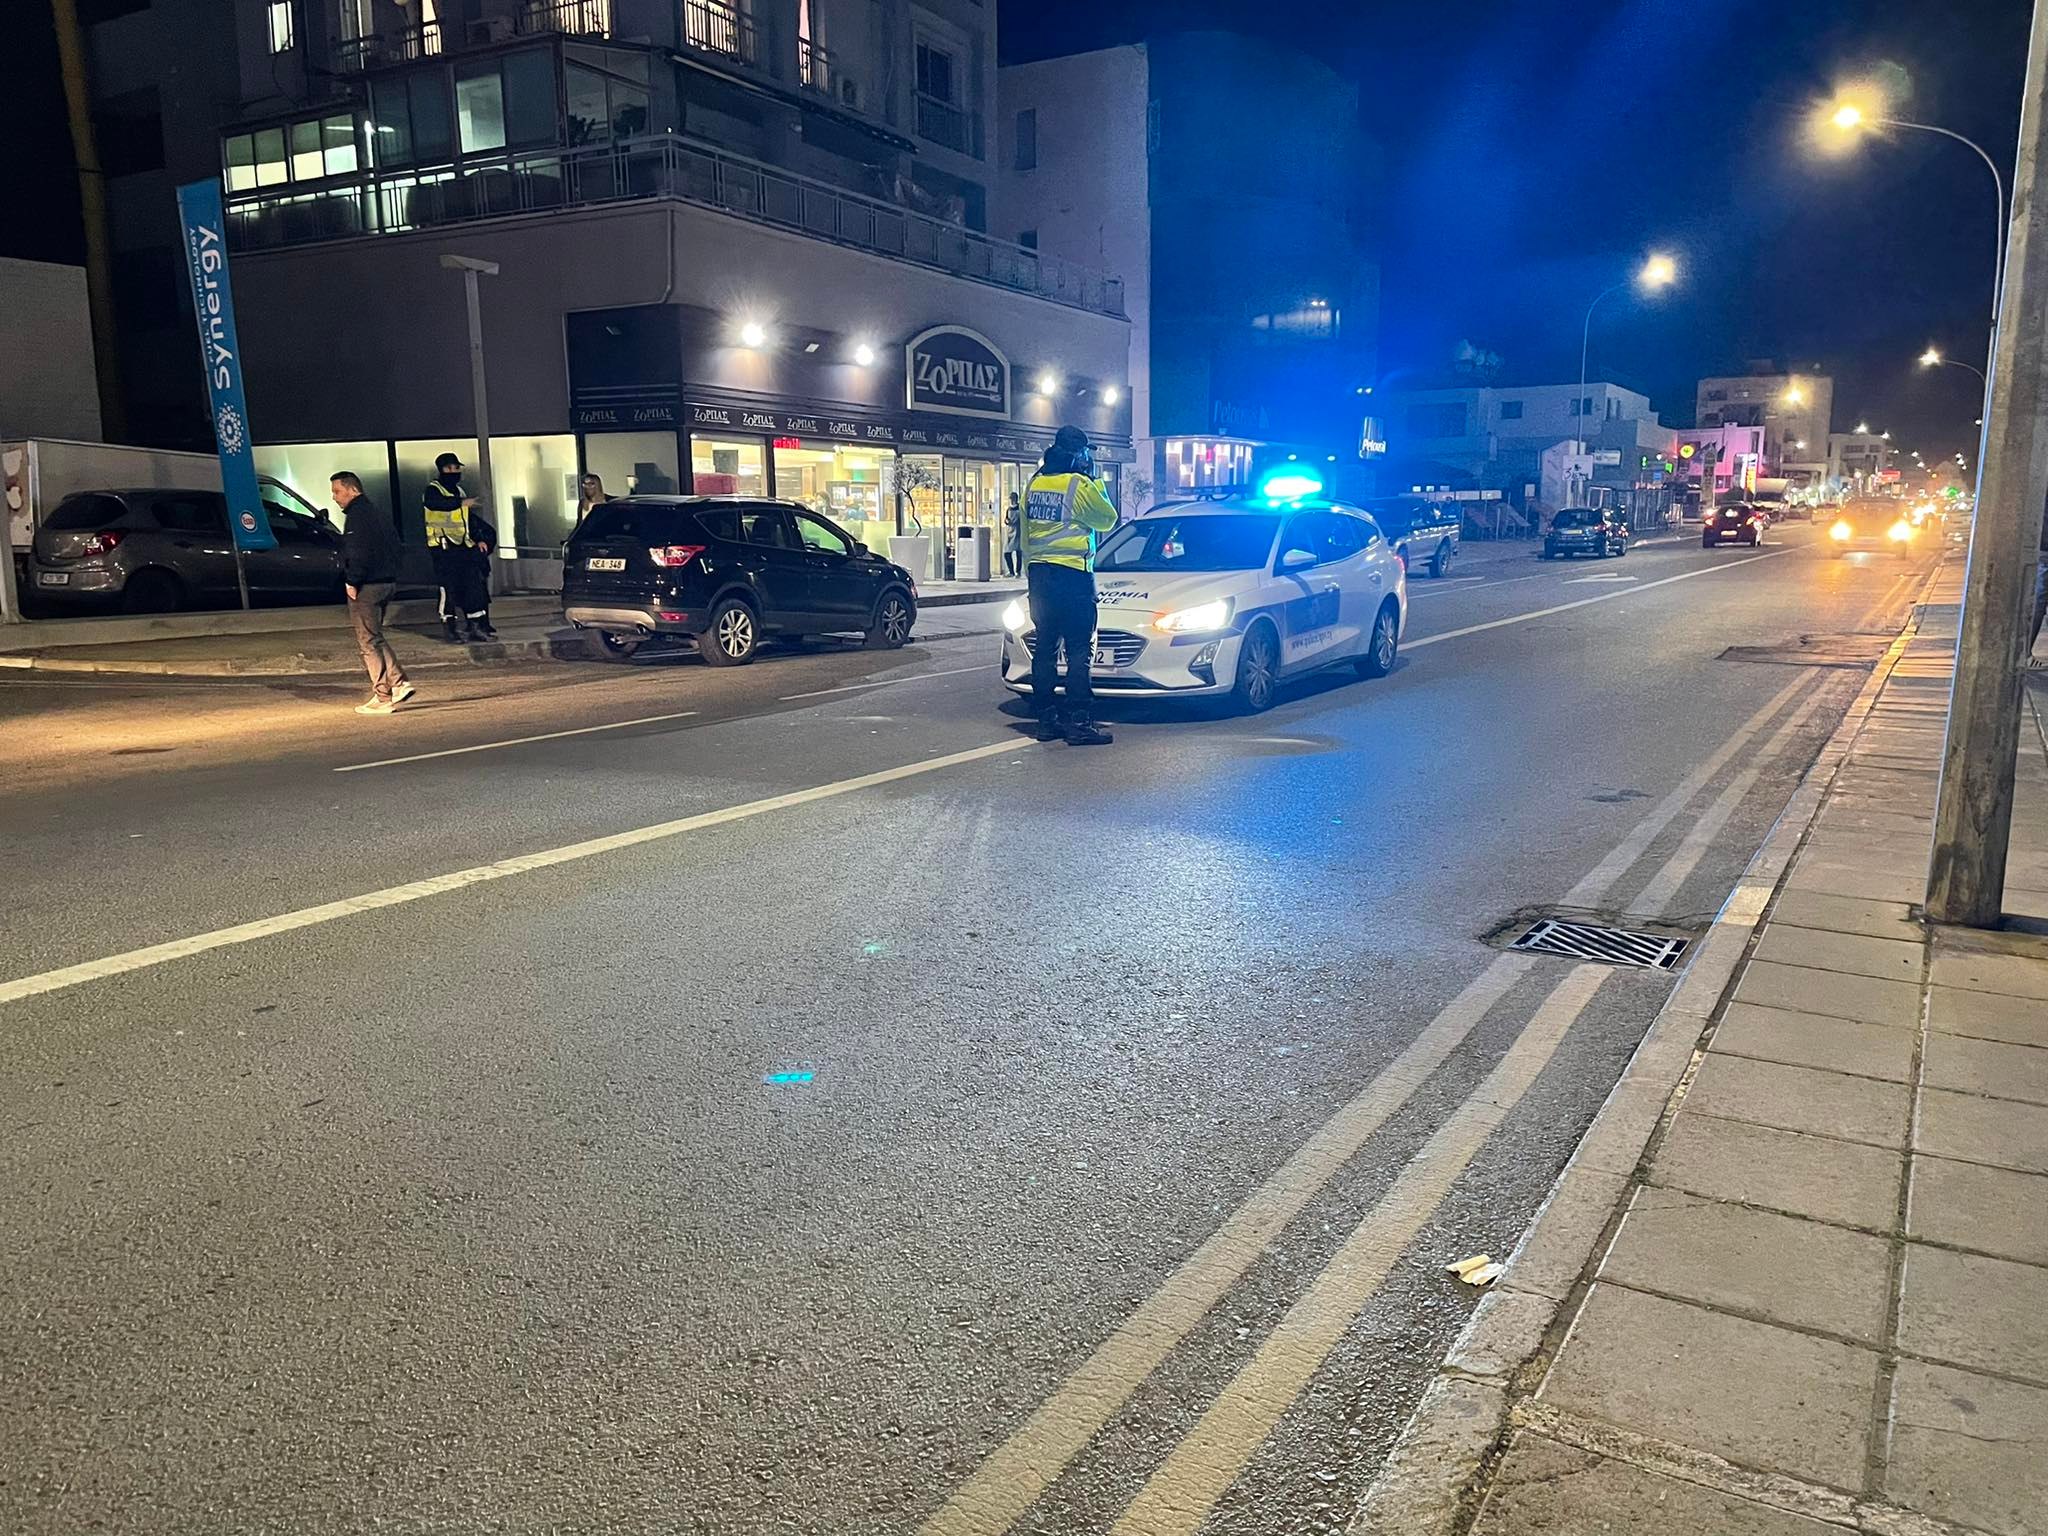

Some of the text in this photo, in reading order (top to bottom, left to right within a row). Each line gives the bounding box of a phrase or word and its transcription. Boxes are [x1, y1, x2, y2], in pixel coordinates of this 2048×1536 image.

[198, 225, 233, 390] Synergy
[917, 352, 999, 394] ΖΟΡΠΑΣ
[694, 408, 729, 424] ΖΟΡΠΑΣ
[742, 413, 775, 428] ΖΟΡΠΑΣ
[1029, 506, 1056, 520] POLICE
